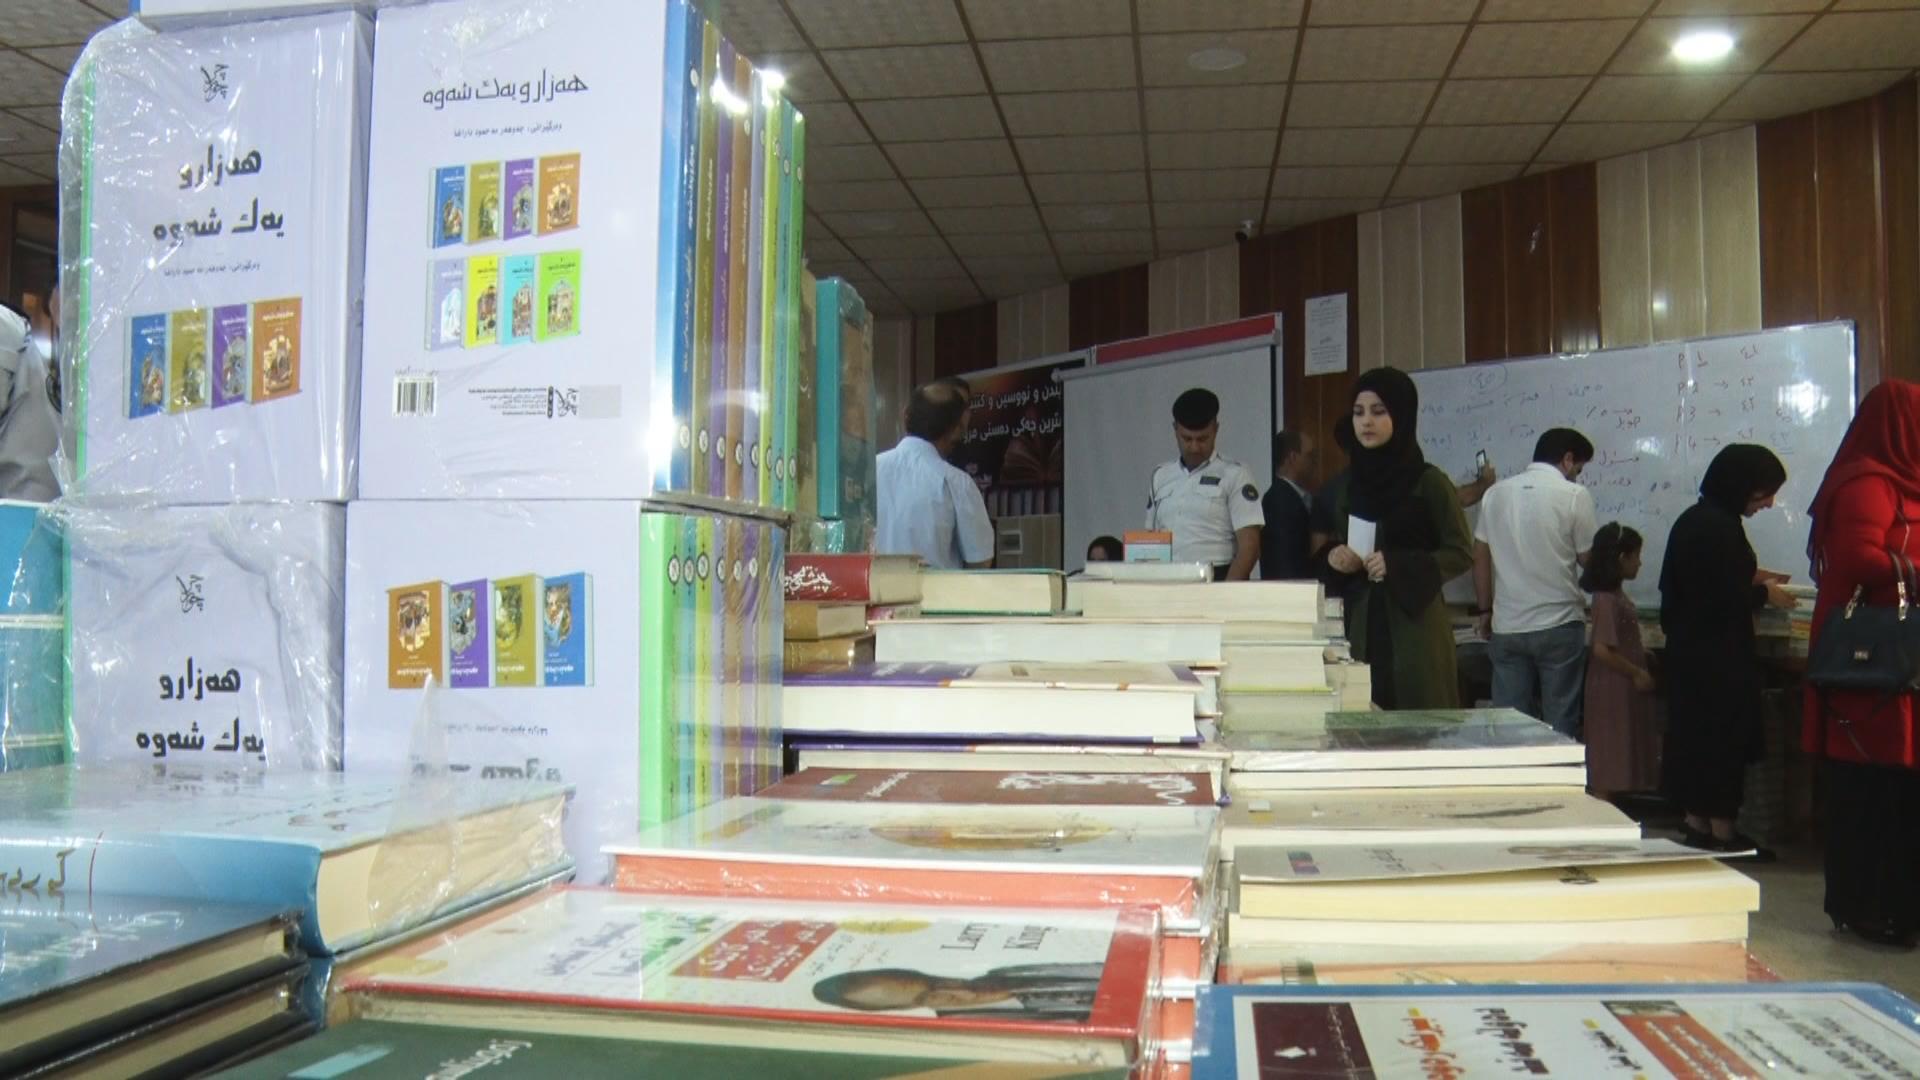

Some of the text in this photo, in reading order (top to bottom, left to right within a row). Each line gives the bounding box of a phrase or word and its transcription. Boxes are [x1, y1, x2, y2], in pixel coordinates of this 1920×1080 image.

[159, 657, 241, 700] هەزارو
[136, 722, 205, 758] شەوە
[941, 922, 998, 951] Larry
[1003, 924, 1057, 951] King
